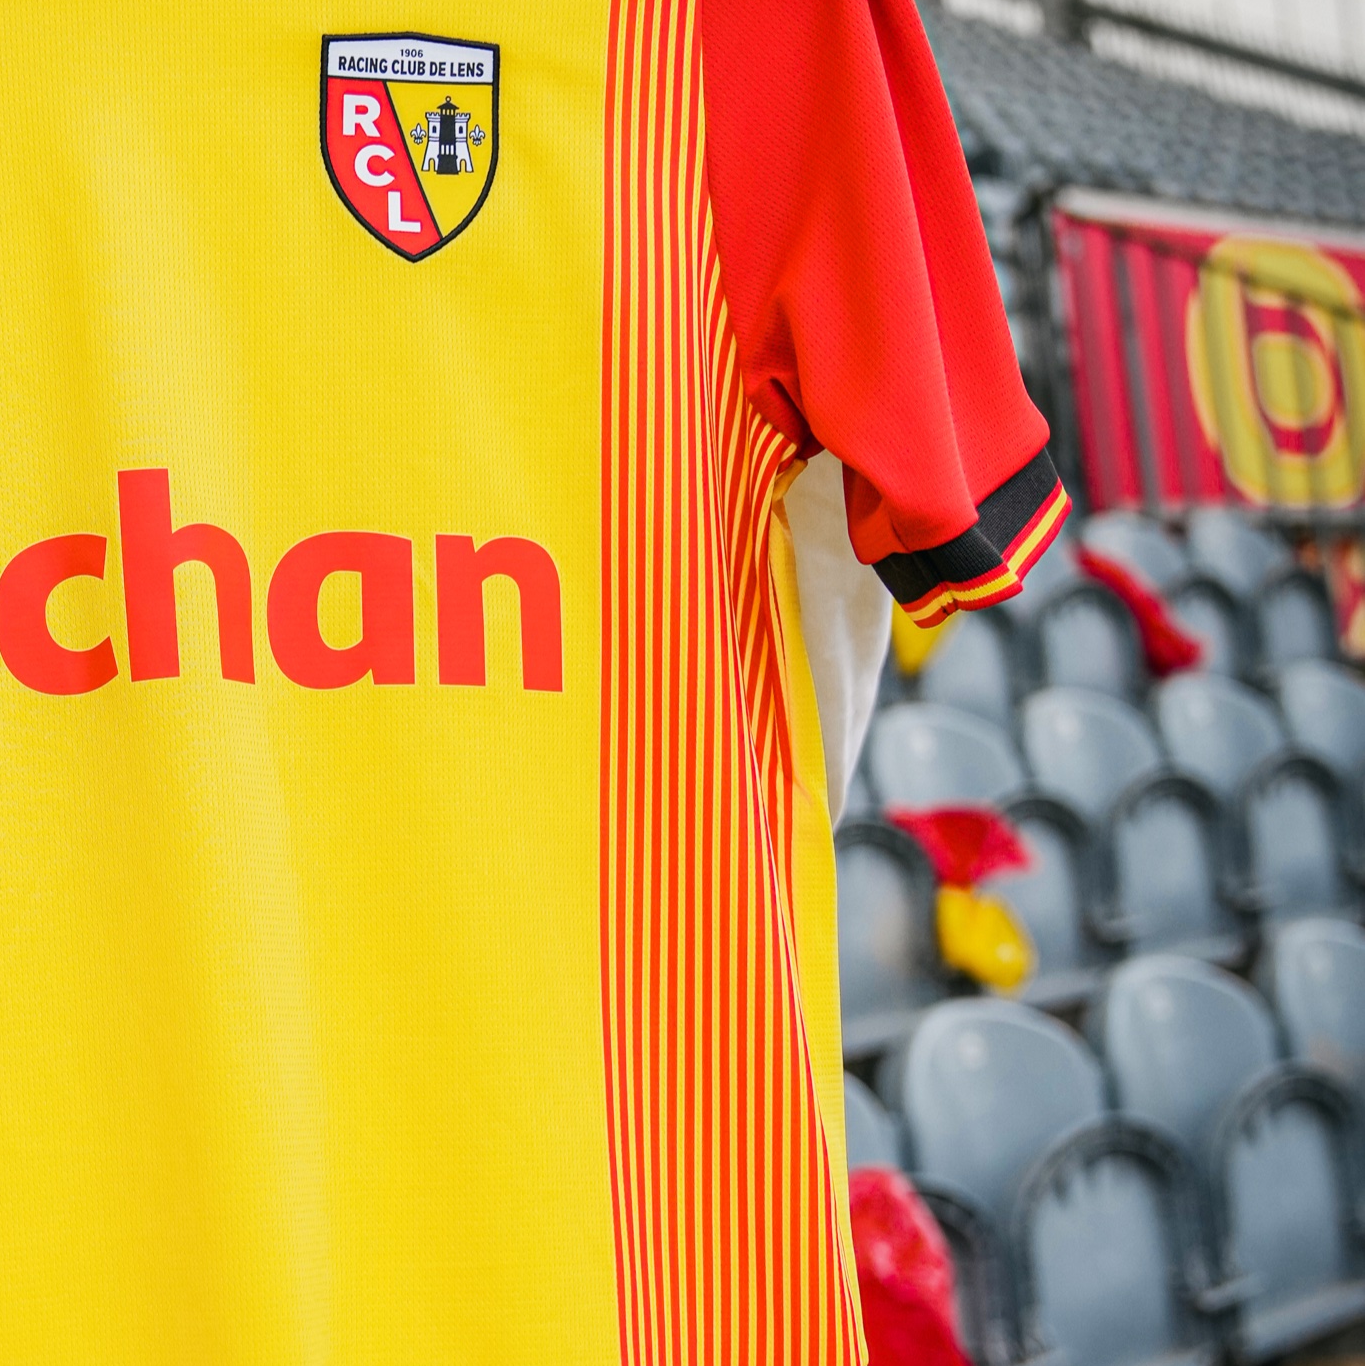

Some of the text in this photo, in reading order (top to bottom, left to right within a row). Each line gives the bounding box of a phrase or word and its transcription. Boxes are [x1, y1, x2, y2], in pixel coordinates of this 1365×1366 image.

[400, 49, 423, 58] 1906
[338, 56, 484, 77] RACING CLUB DE LENS
